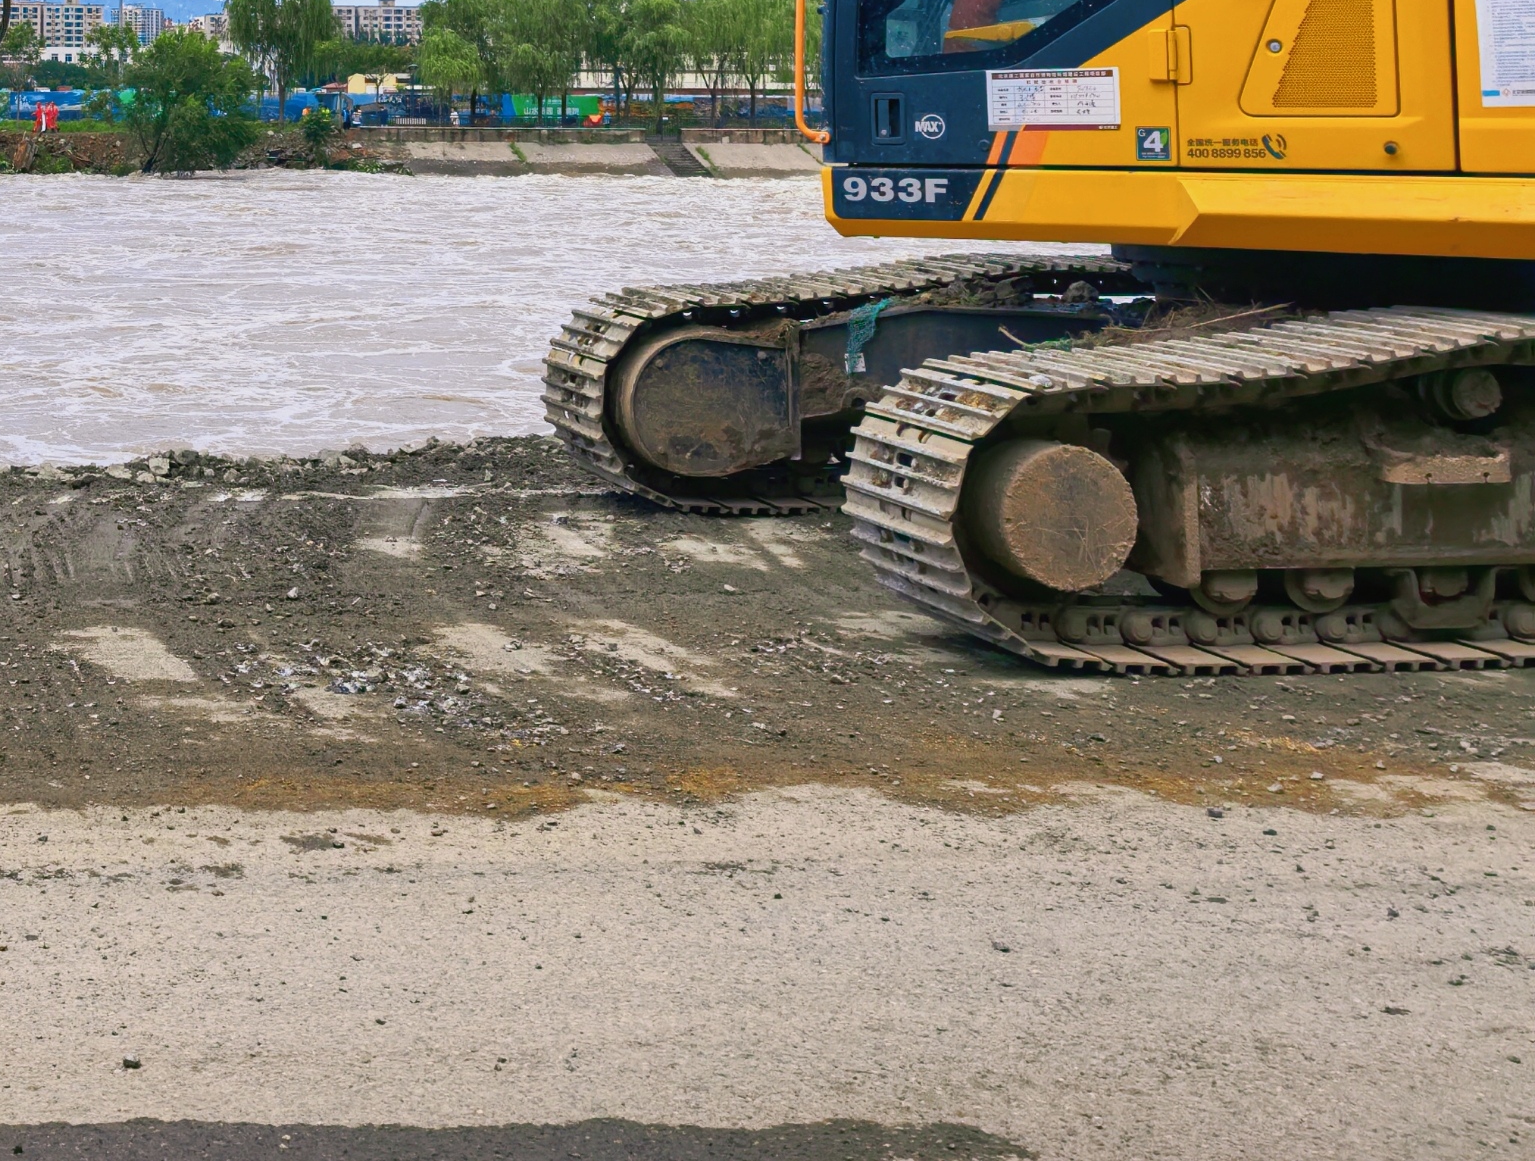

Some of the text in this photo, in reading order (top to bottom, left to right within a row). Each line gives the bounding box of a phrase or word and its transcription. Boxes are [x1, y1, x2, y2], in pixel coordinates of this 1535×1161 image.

[1138, 129, 1163, 152] G 4
[1187, 148, 1267, 158] 400 8899 856
[843, 177, 948, 203] 933F
